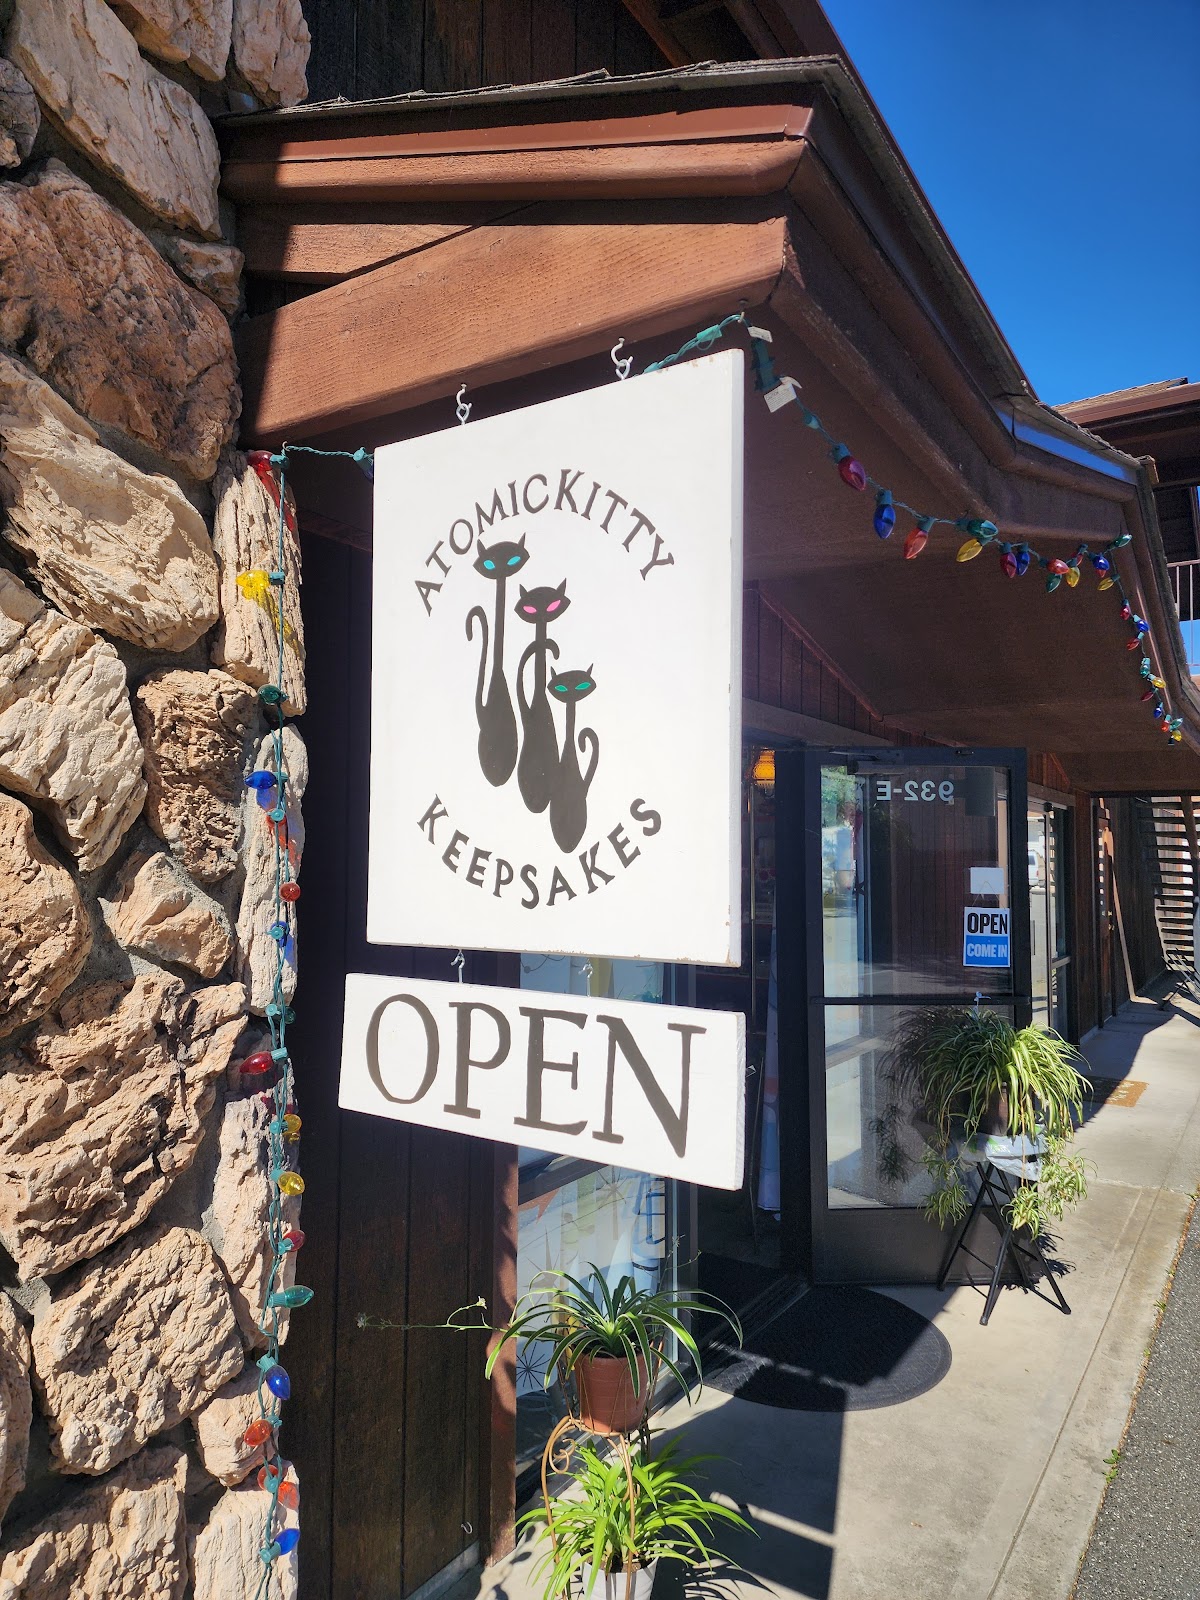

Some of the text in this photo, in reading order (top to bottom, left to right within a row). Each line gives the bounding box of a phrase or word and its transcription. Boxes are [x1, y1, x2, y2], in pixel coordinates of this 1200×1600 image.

[414, 469, 676, 617] ATOMICKITTY
[416, 794, 663, 910] KEEPSAKES
[966, 943, 1008, 958] COME IN
[967, 913, 1008, 934] OPEN
[365, 992, 708, 1159] OPEN
